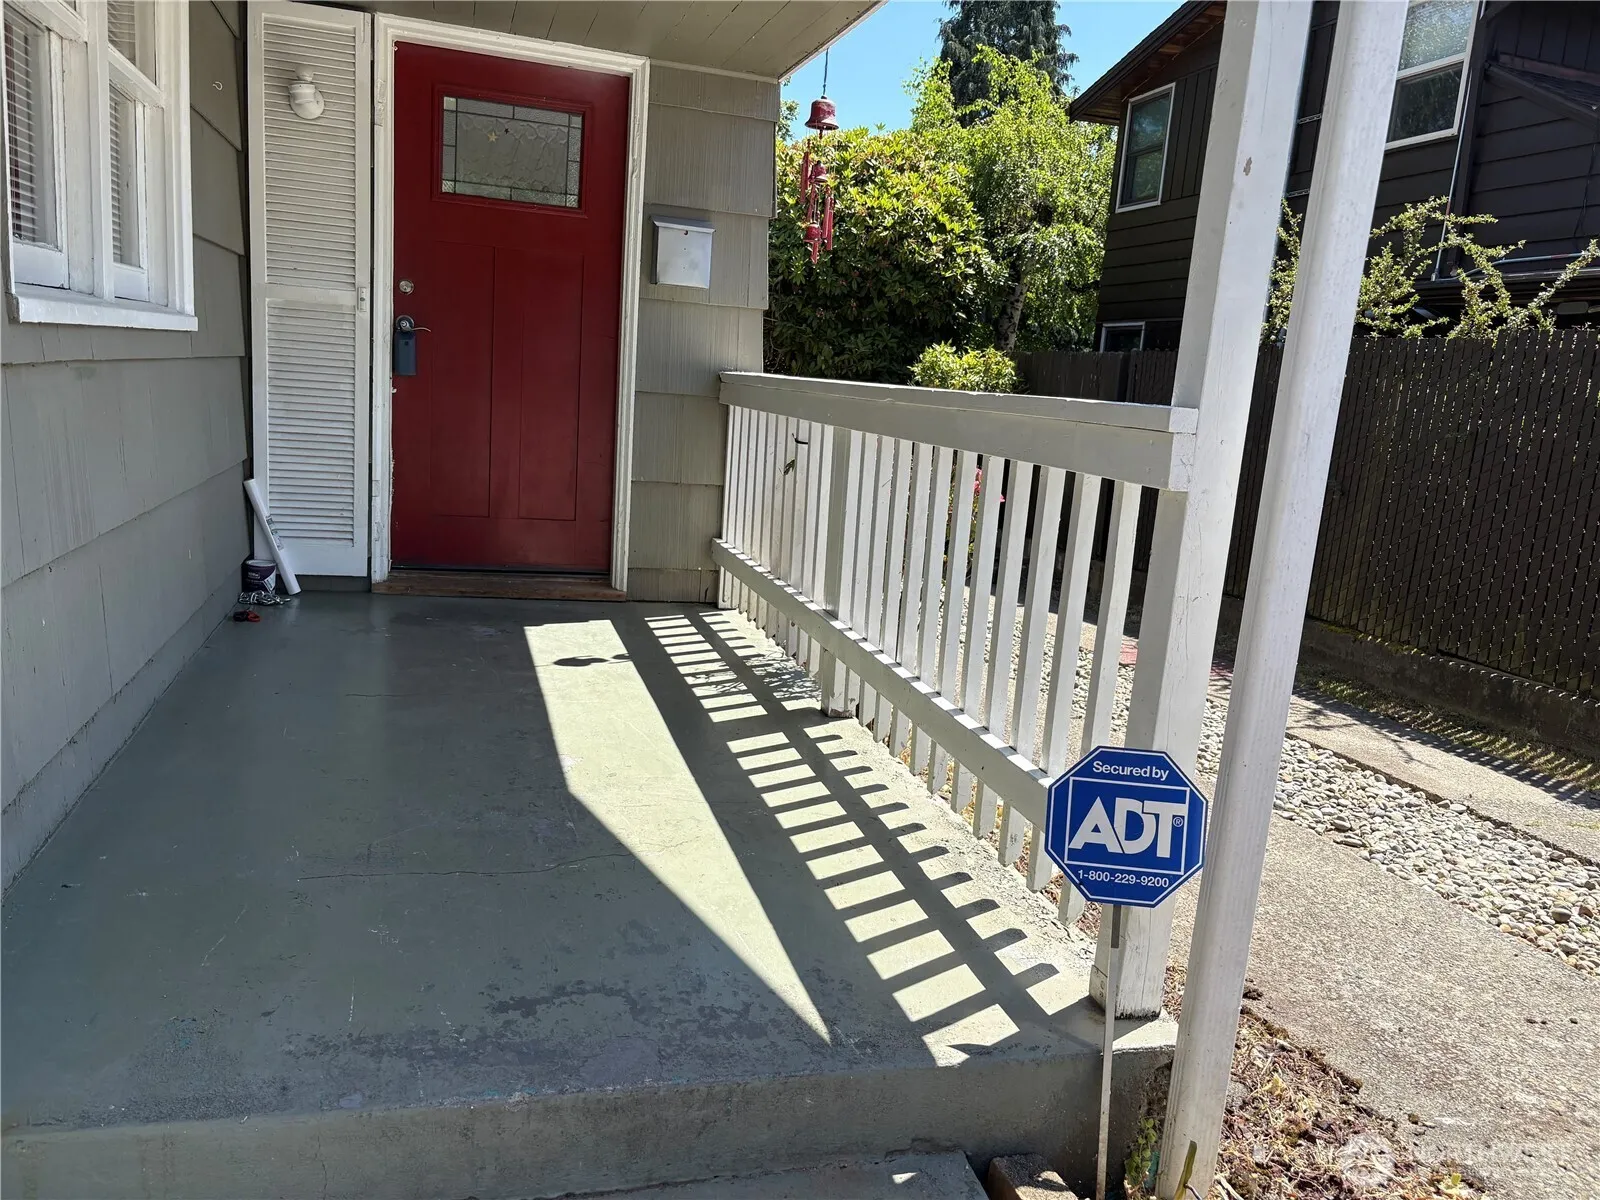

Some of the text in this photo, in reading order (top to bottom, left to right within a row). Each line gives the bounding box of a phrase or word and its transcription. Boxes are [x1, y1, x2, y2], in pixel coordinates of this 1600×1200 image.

[1092, 760, 1169, 781] Secured by
[1078, 869, 1169, 888] 1-800-229-9200
